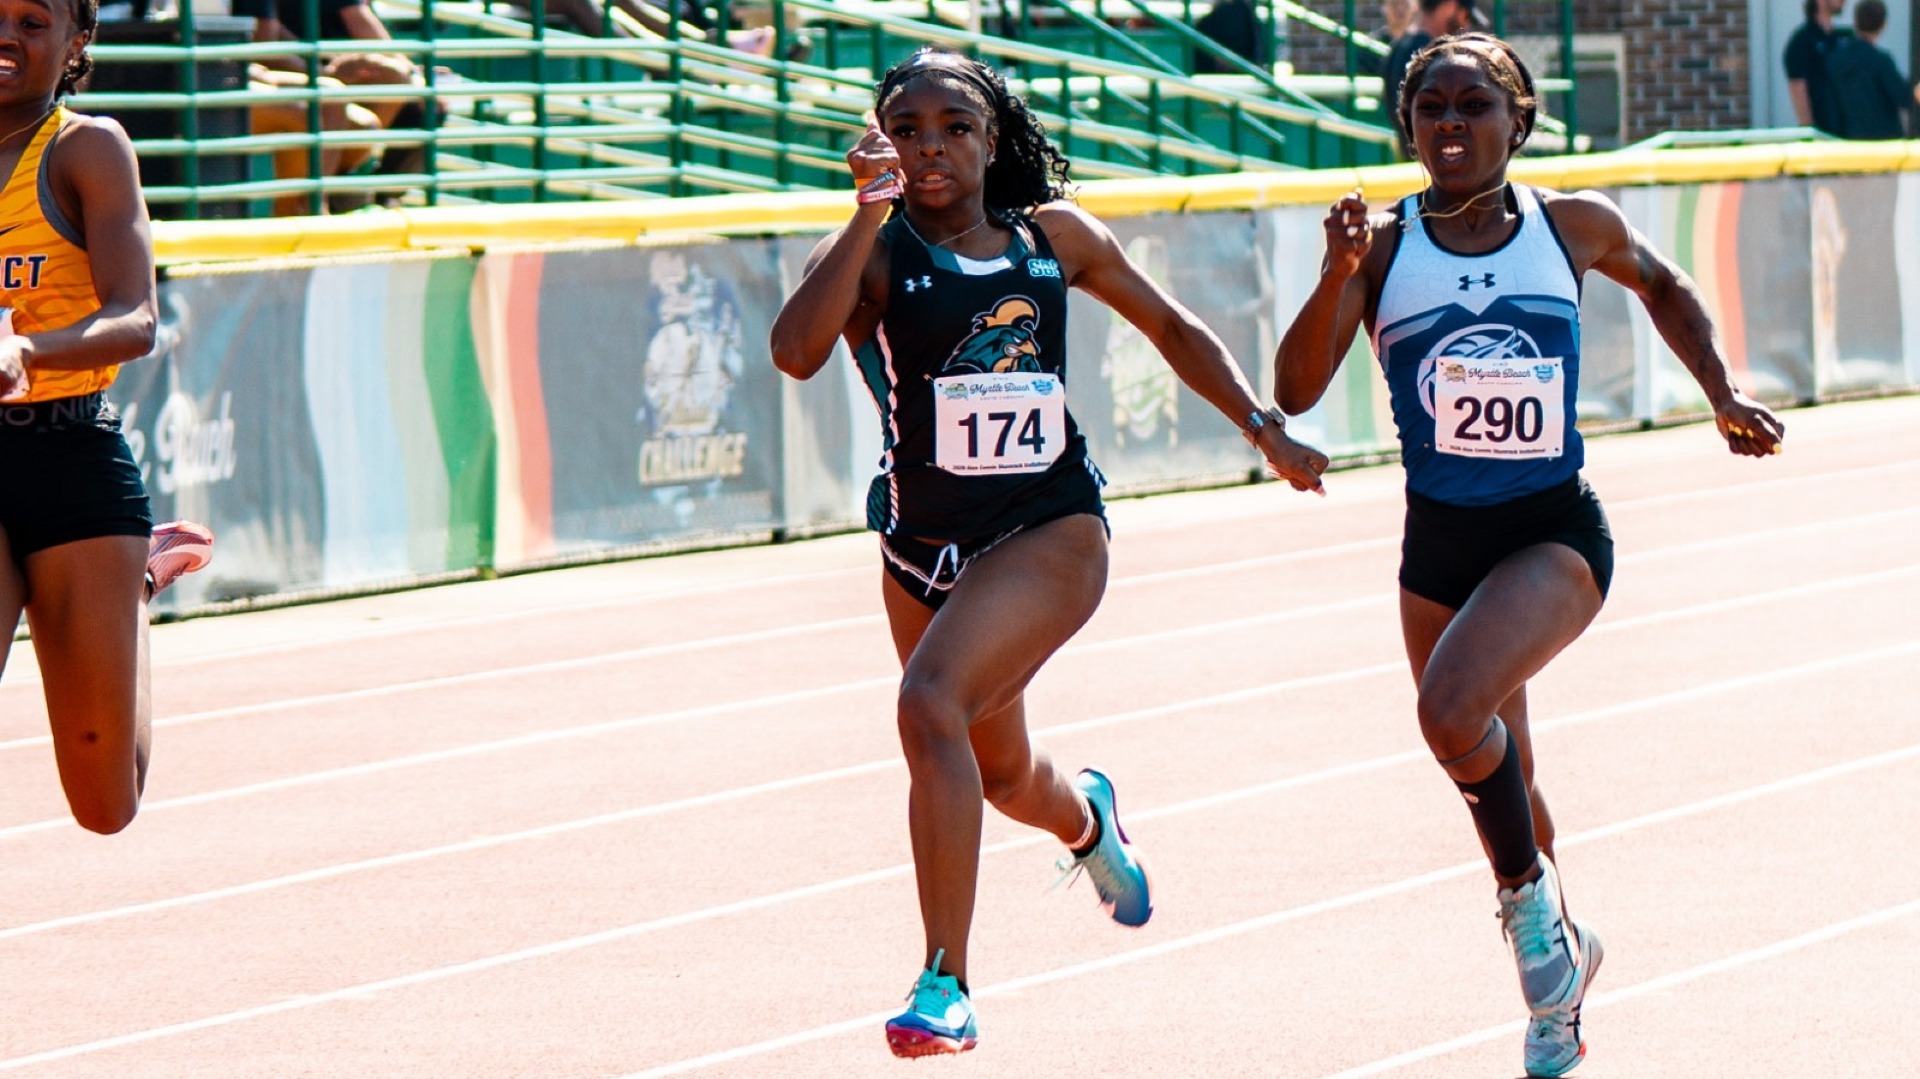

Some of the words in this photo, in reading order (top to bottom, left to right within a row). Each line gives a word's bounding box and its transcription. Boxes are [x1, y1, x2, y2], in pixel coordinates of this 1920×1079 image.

[0, 253, 48, 290] CT
[969, 382, 1003, 396] Myrtle
[1004, 382, 1030, 392] Beach
[1467, 367, 1501, 380] Myrtle
[1502, 368, 1531, 378] Beach
[958, 408, 1046, 458] 174
[1454, 396, 1544, 443] 290
